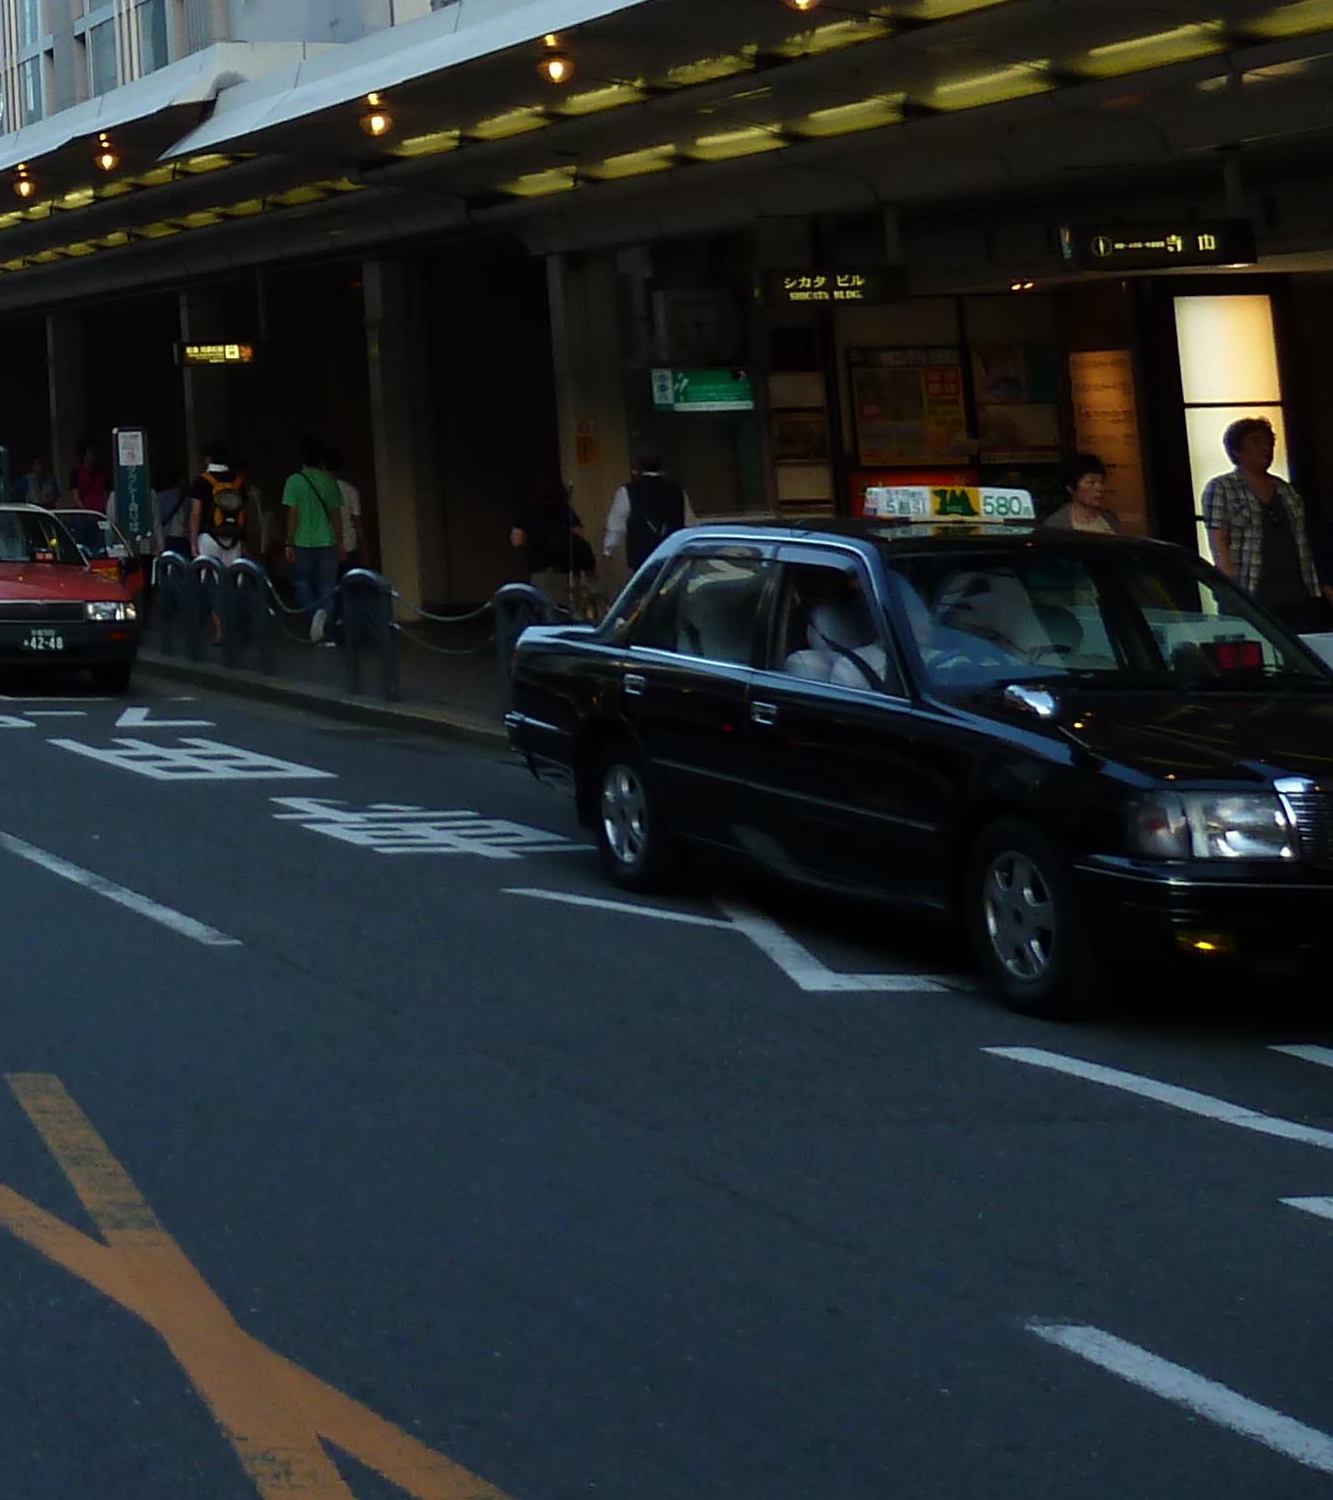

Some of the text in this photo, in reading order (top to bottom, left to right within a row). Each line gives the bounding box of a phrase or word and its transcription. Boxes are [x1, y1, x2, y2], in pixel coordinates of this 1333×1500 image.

[782, 274, 866, 289] シカタ ビル
